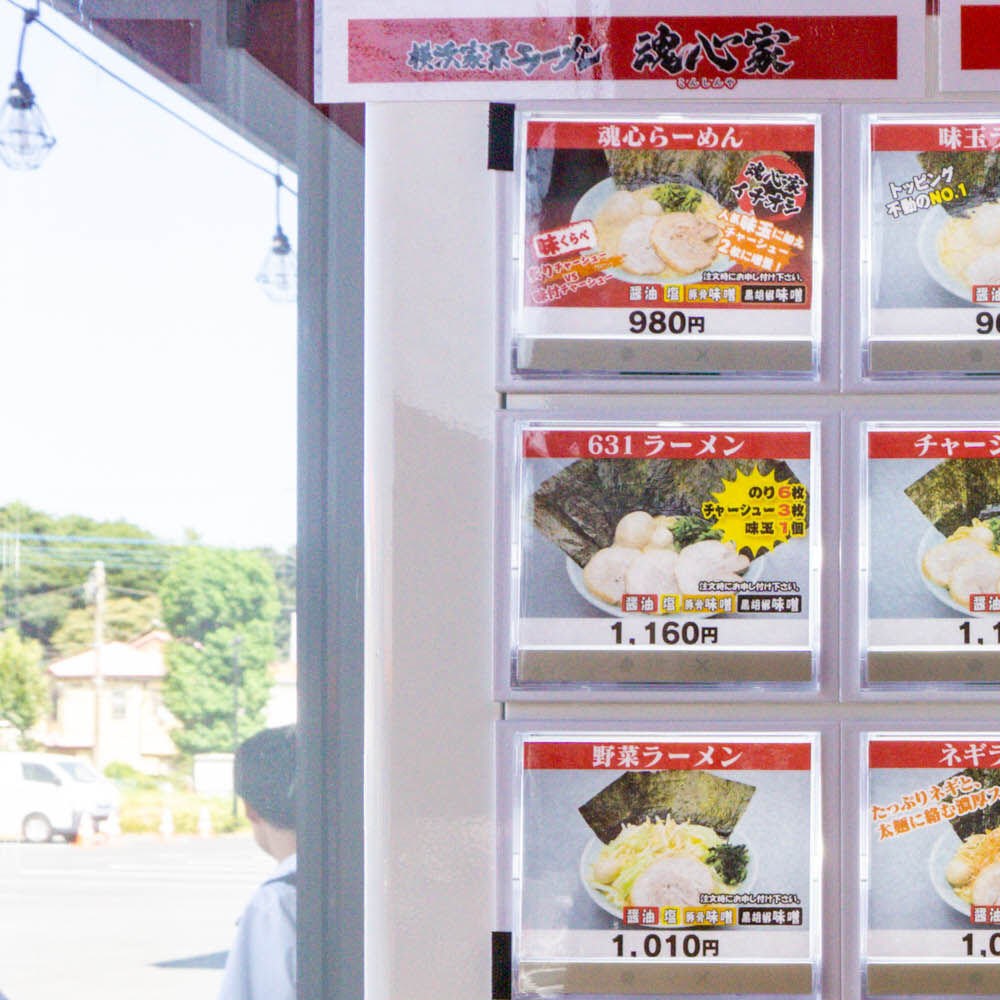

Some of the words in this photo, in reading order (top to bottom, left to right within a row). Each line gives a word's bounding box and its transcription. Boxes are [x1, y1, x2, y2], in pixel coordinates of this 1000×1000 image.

[630, 22, 801, 75] 魂心家
[597, 126, 743, 150] 魂心らーめん
[889, 166, 954, 200] トッピング
[629, 311, 705, 335] 980円
[702, 502, 806, 518] チャーシュー3枚
[610, 621, 719, 646] 1,160円
[591, 745, 744, 769] 野菜ラーメン
[612, 933, 720, 958] 1,010円
